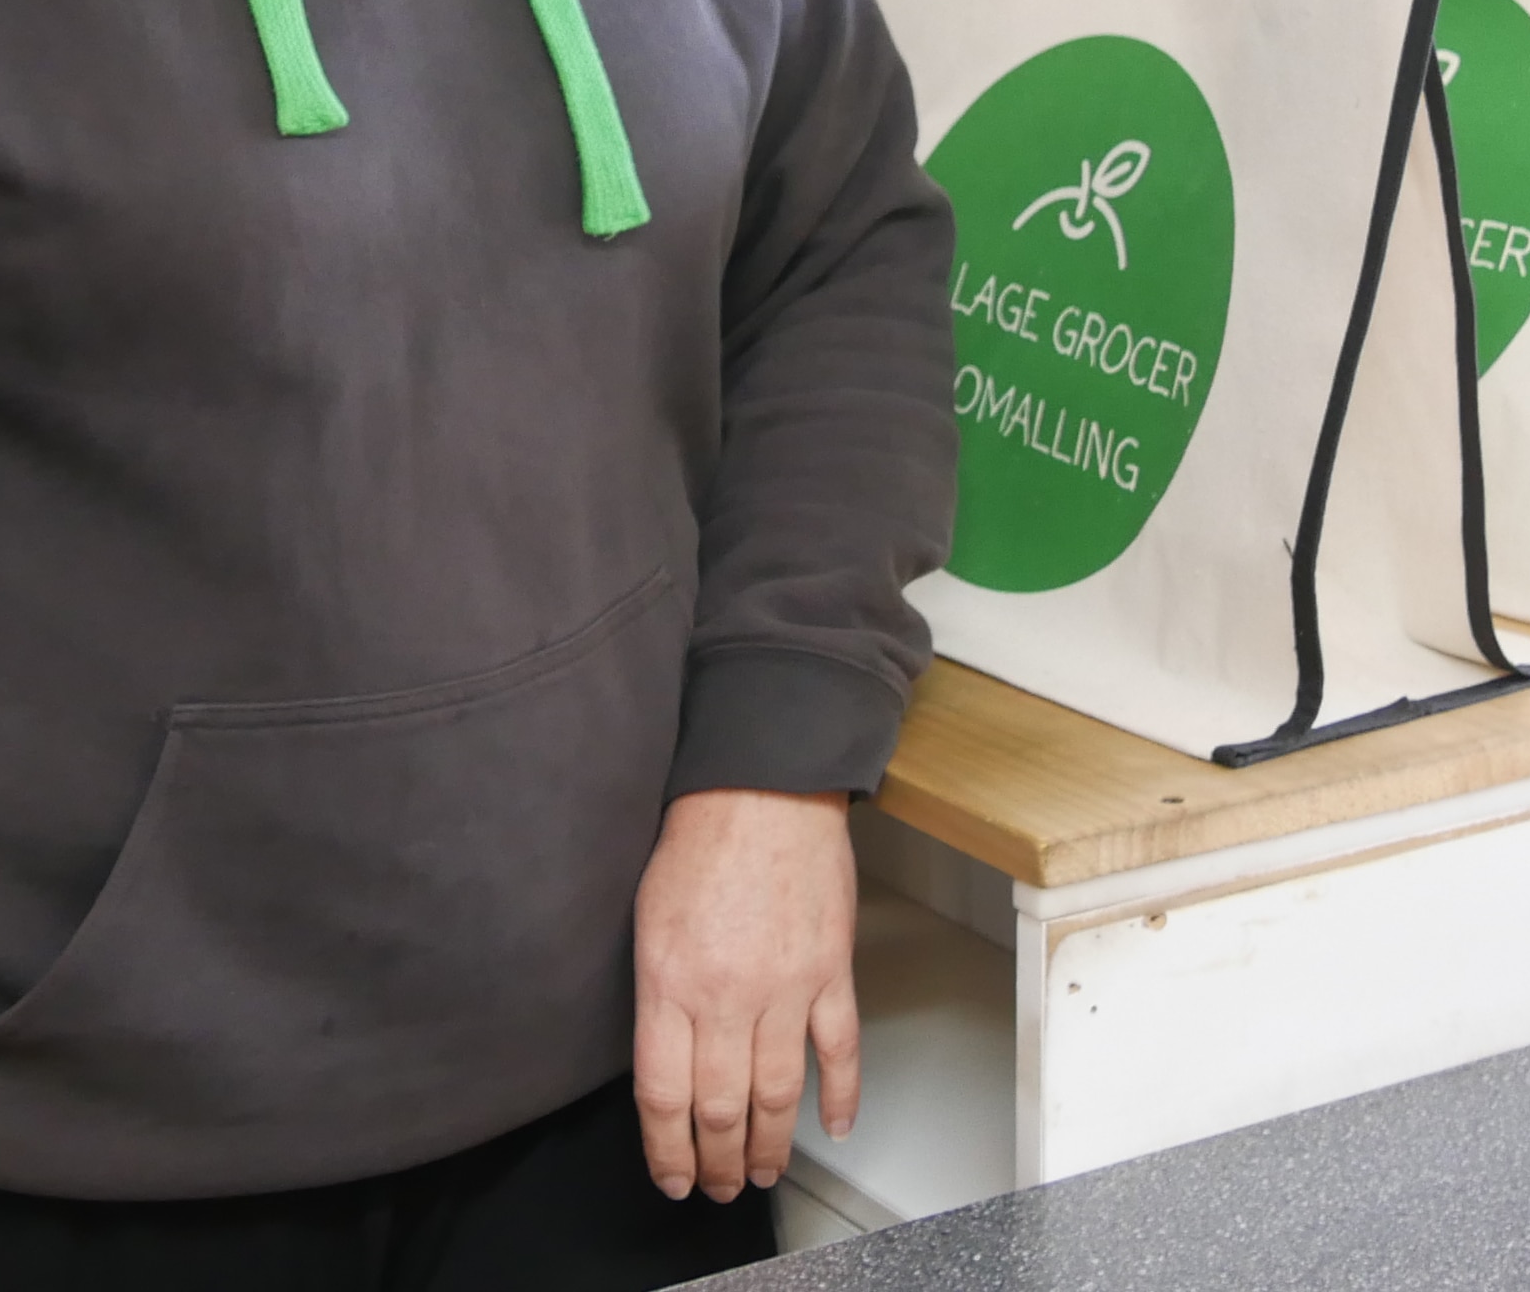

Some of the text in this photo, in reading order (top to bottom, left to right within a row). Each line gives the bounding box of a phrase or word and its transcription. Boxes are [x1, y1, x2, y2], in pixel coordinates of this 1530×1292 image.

[951, 262, 1197, 407] LAGE GROCER
[953, 364, 1140, 492] OMALLING
